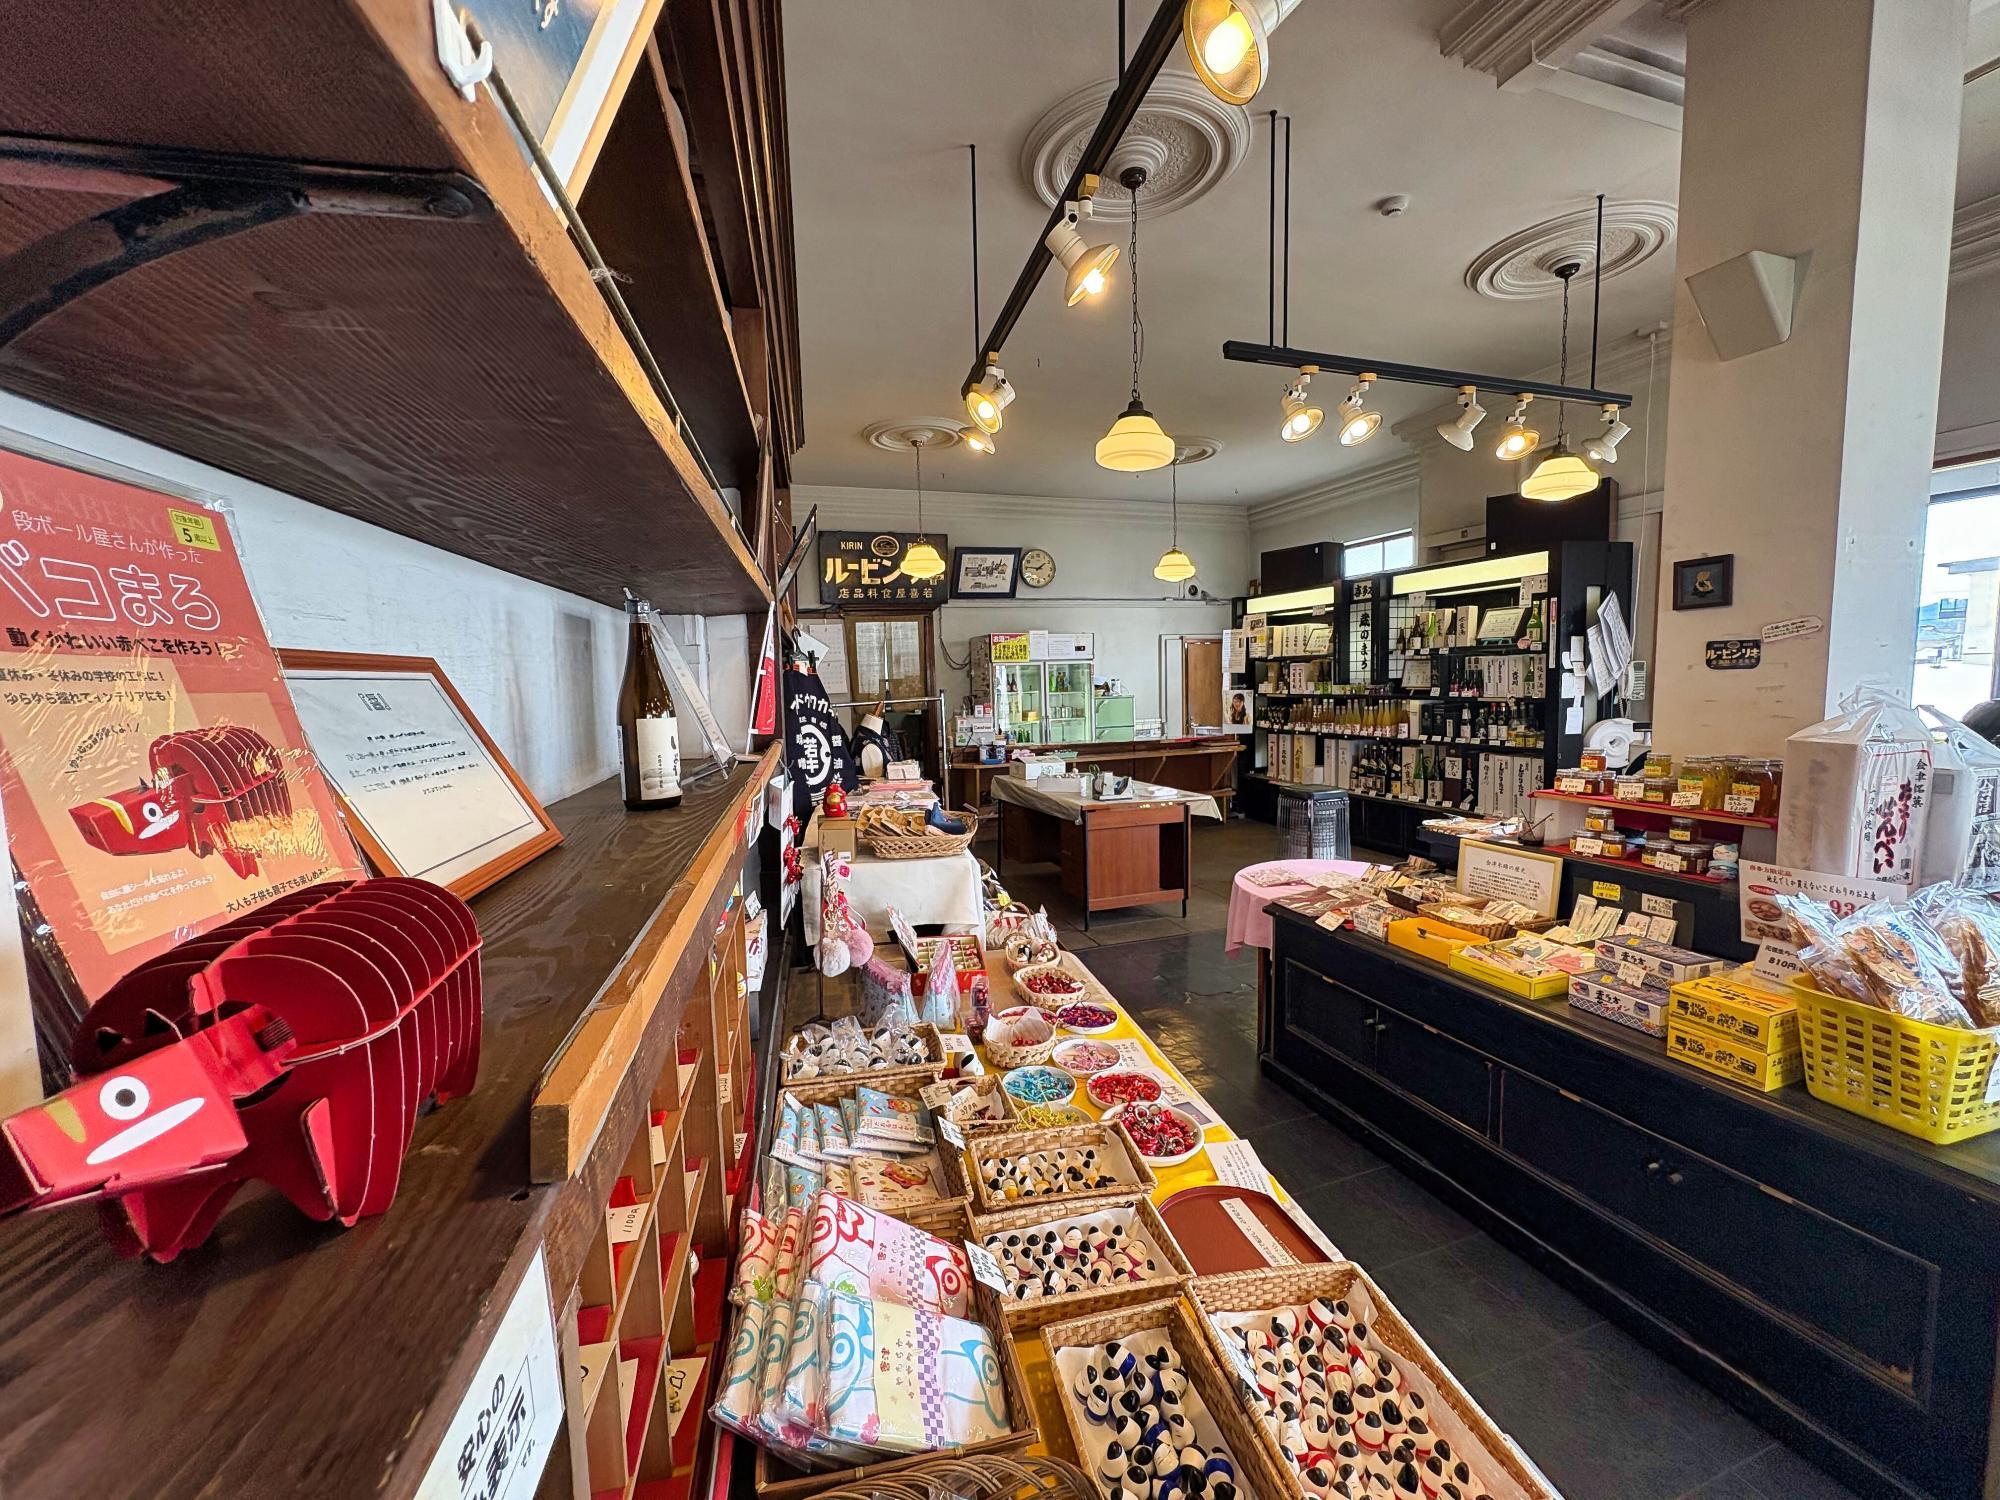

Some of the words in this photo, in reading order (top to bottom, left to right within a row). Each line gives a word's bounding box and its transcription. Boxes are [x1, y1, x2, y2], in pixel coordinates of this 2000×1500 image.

[12, 509, 204, 565] 段ボール屋さんが作った
[840, 541, 863, 551] KIRIN
[1768, 957, 1797, 972] 810円
